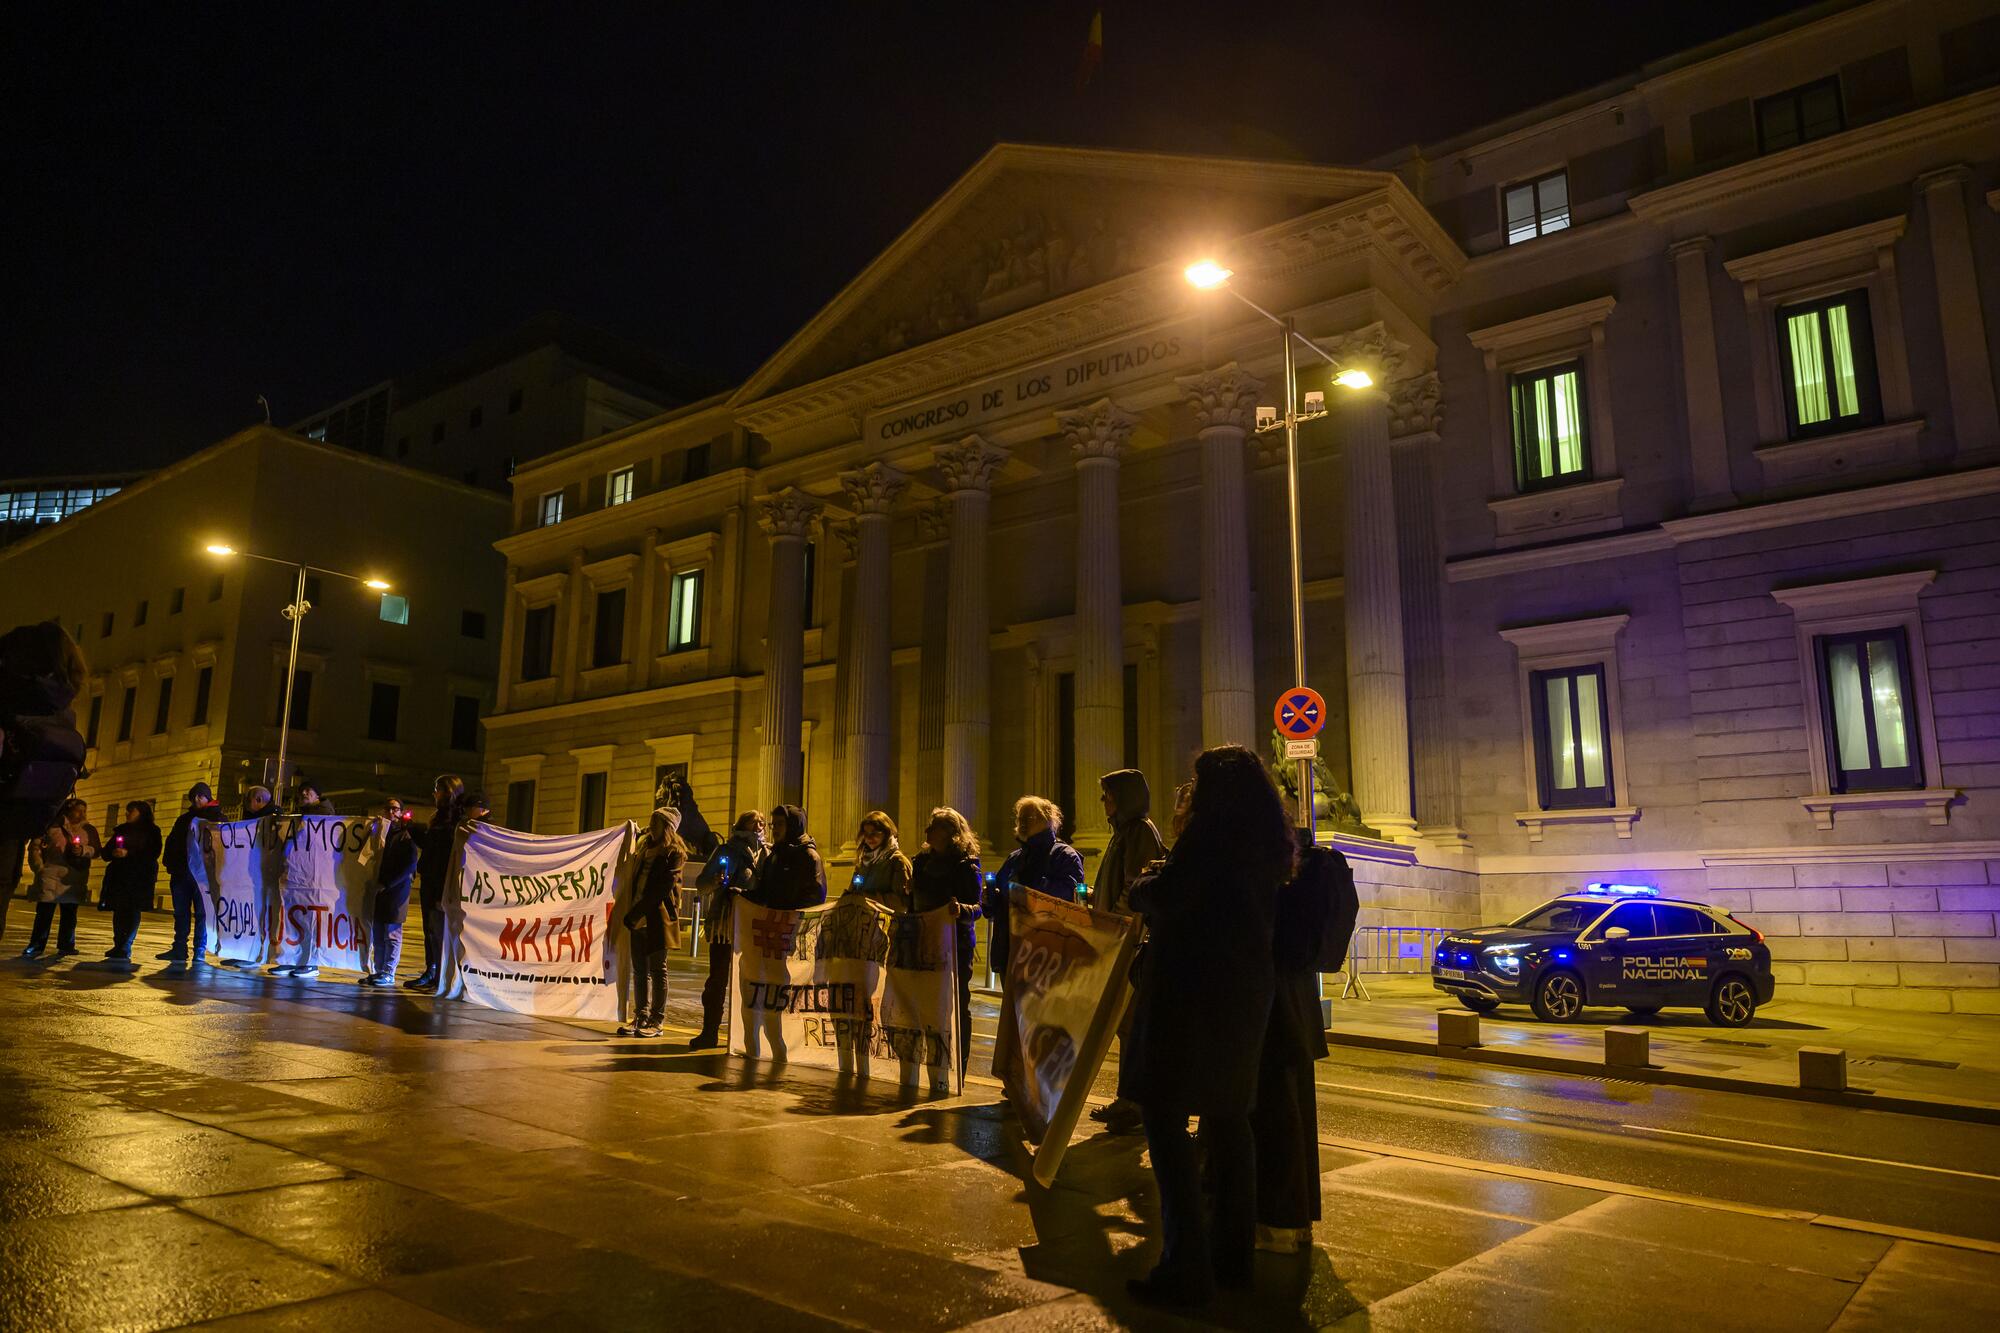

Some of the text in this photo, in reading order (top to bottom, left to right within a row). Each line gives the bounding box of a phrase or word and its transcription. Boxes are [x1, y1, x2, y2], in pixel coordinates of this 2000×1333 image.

[880, 337, 1181, 440] CONGRESO DE LOS DIPUTADOS
[460, 862, 608, 906] LAS FRONTERAS
[498, 914, 594, 963] MATAN
[1011, 938, 1063, 993] POR
[1622, 957, 1690, 968] POLICIA
[1622, 968, 1709, 980] NACIONAL
[748, 981, 855, 1014] JUSTICIA
